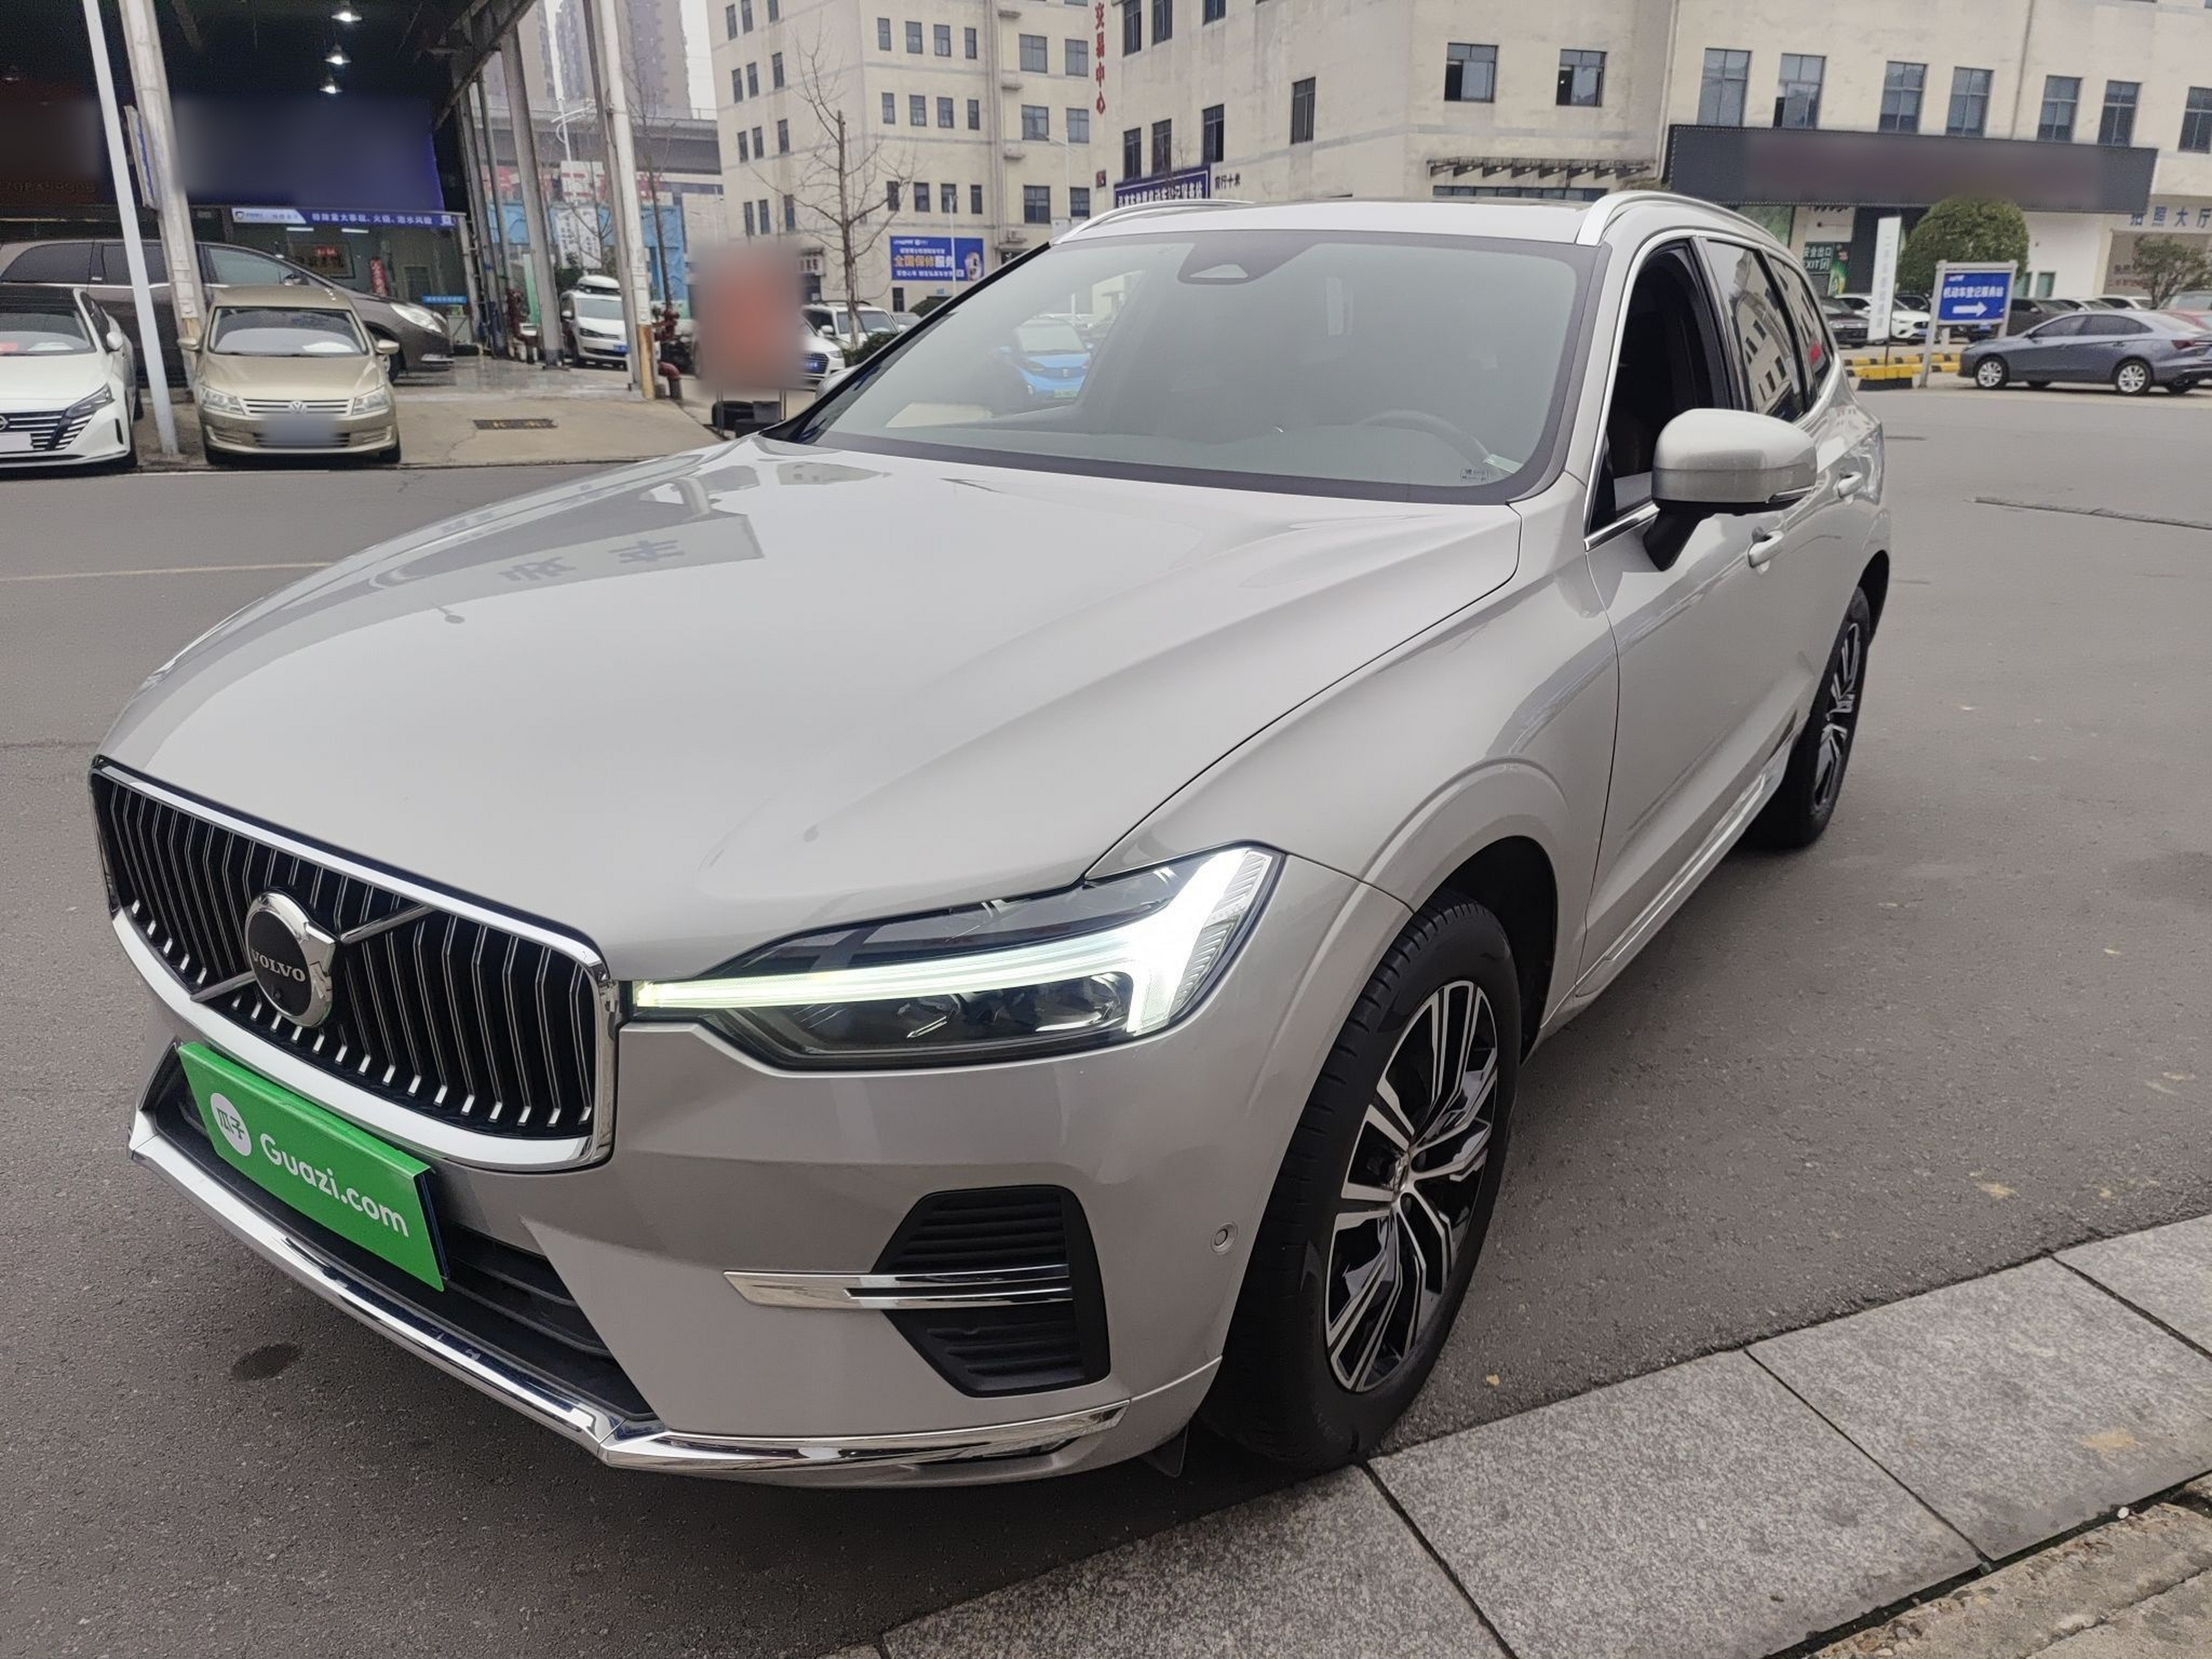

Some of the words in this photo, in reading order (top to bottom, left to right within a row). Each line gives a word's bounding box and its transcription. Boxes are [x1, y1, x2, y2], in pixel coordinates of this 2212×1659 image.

[1095, 2, 1105, 114] 交易中心
[252, 948, 306, 982] VOLVO
[216, 1107, 245, 1140] 瓜子
[260, 1133, 409, 1237] Guazi.com
